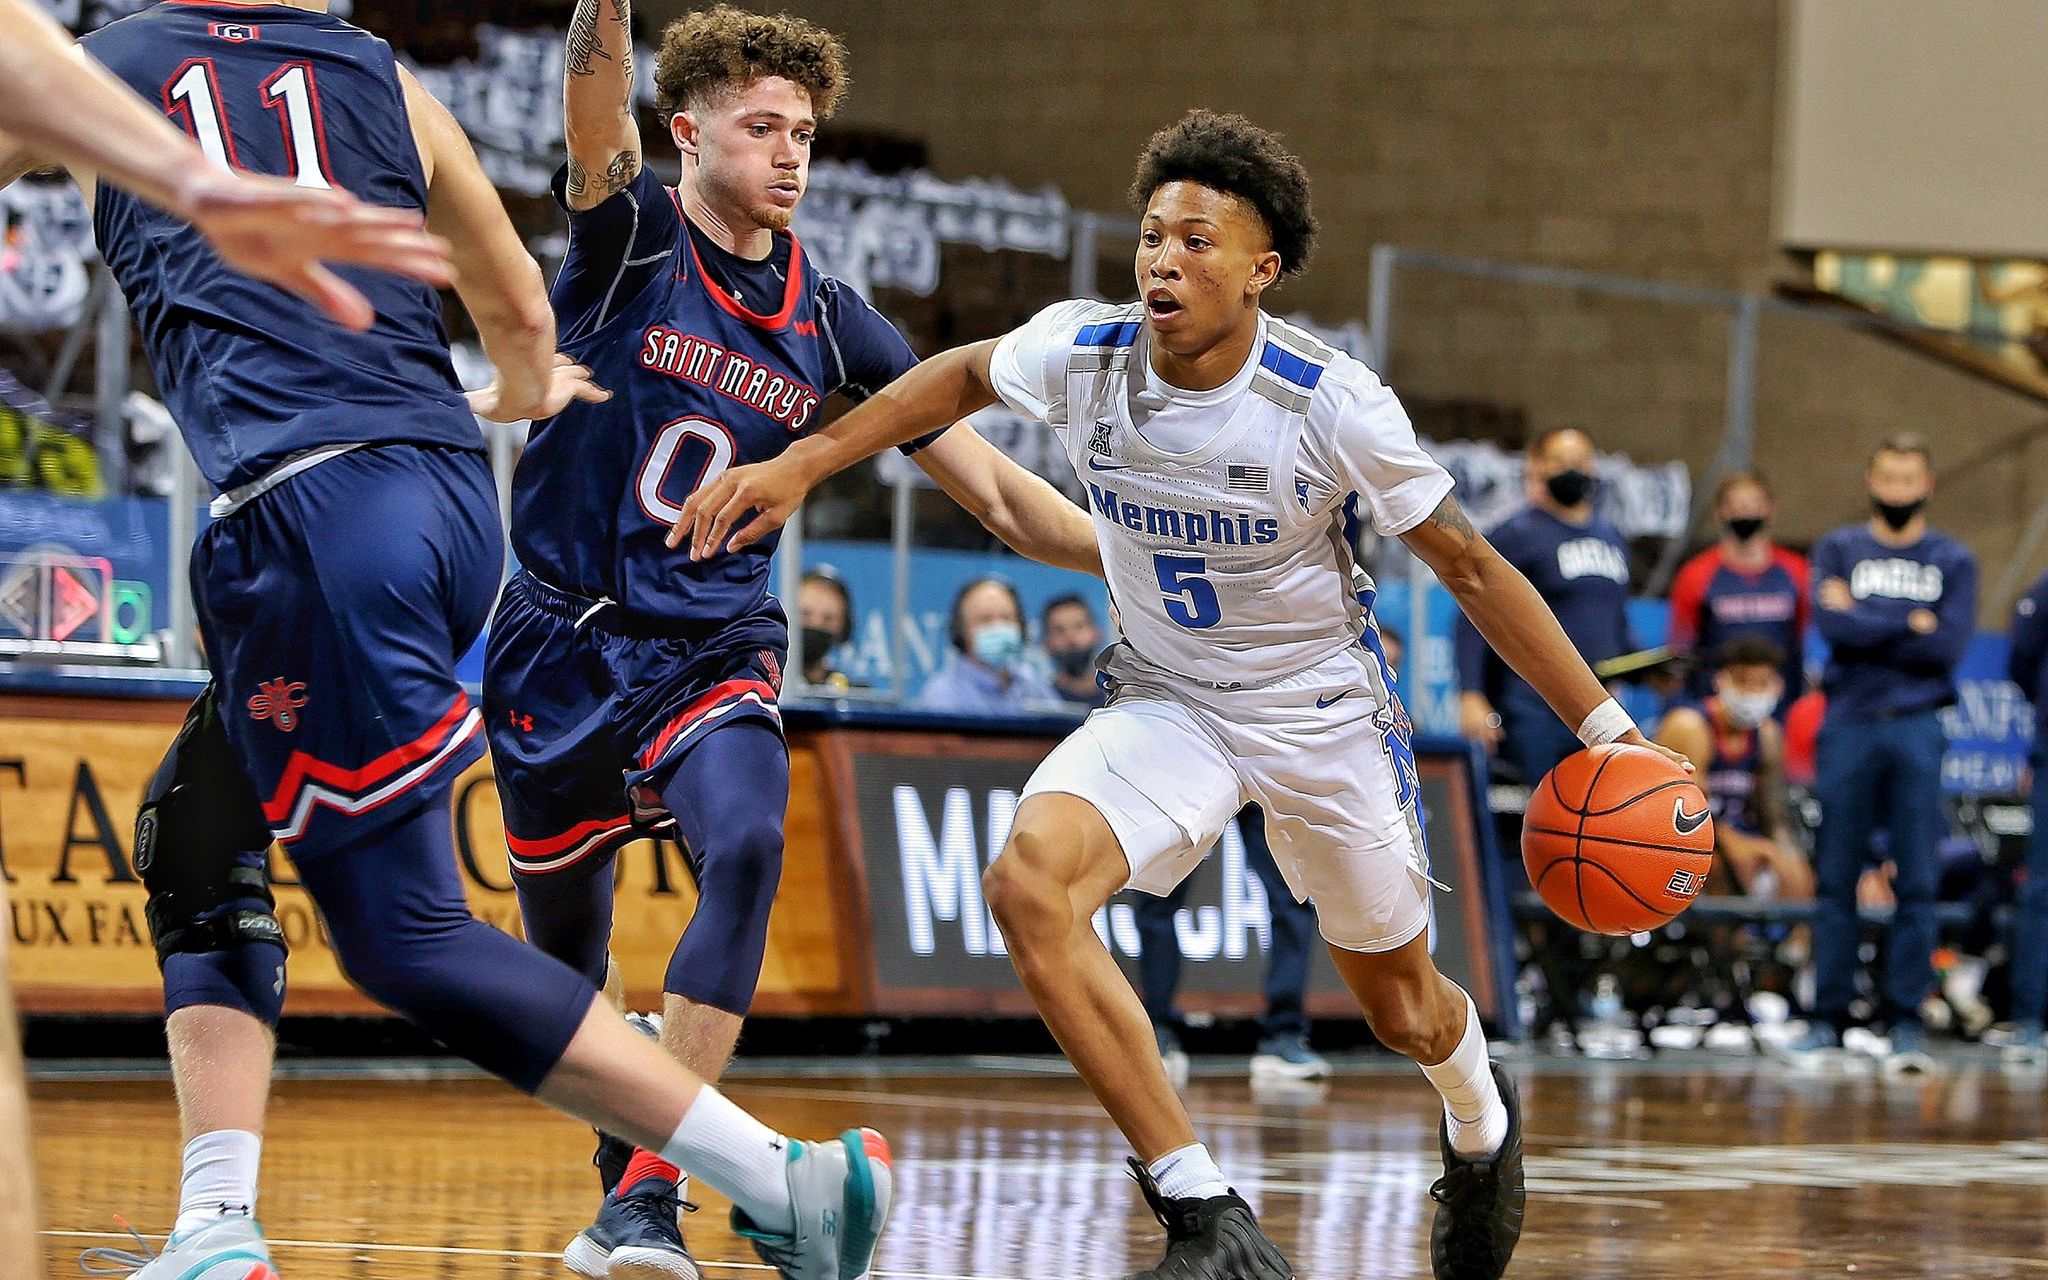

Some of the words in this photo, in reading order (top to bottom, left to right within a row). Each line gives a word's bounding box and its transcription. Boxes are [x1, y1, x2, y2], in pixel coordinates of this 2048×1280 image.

[161, 57, 345, 190] 11
[640, 327, 726, 387] SAINT
[714, 352, 822, 432] MARY'S
[635, 414, 737, 526] 0
[1087, 480, 1280, 546] Memphis
[1153, 552, 1222, 629] 5
